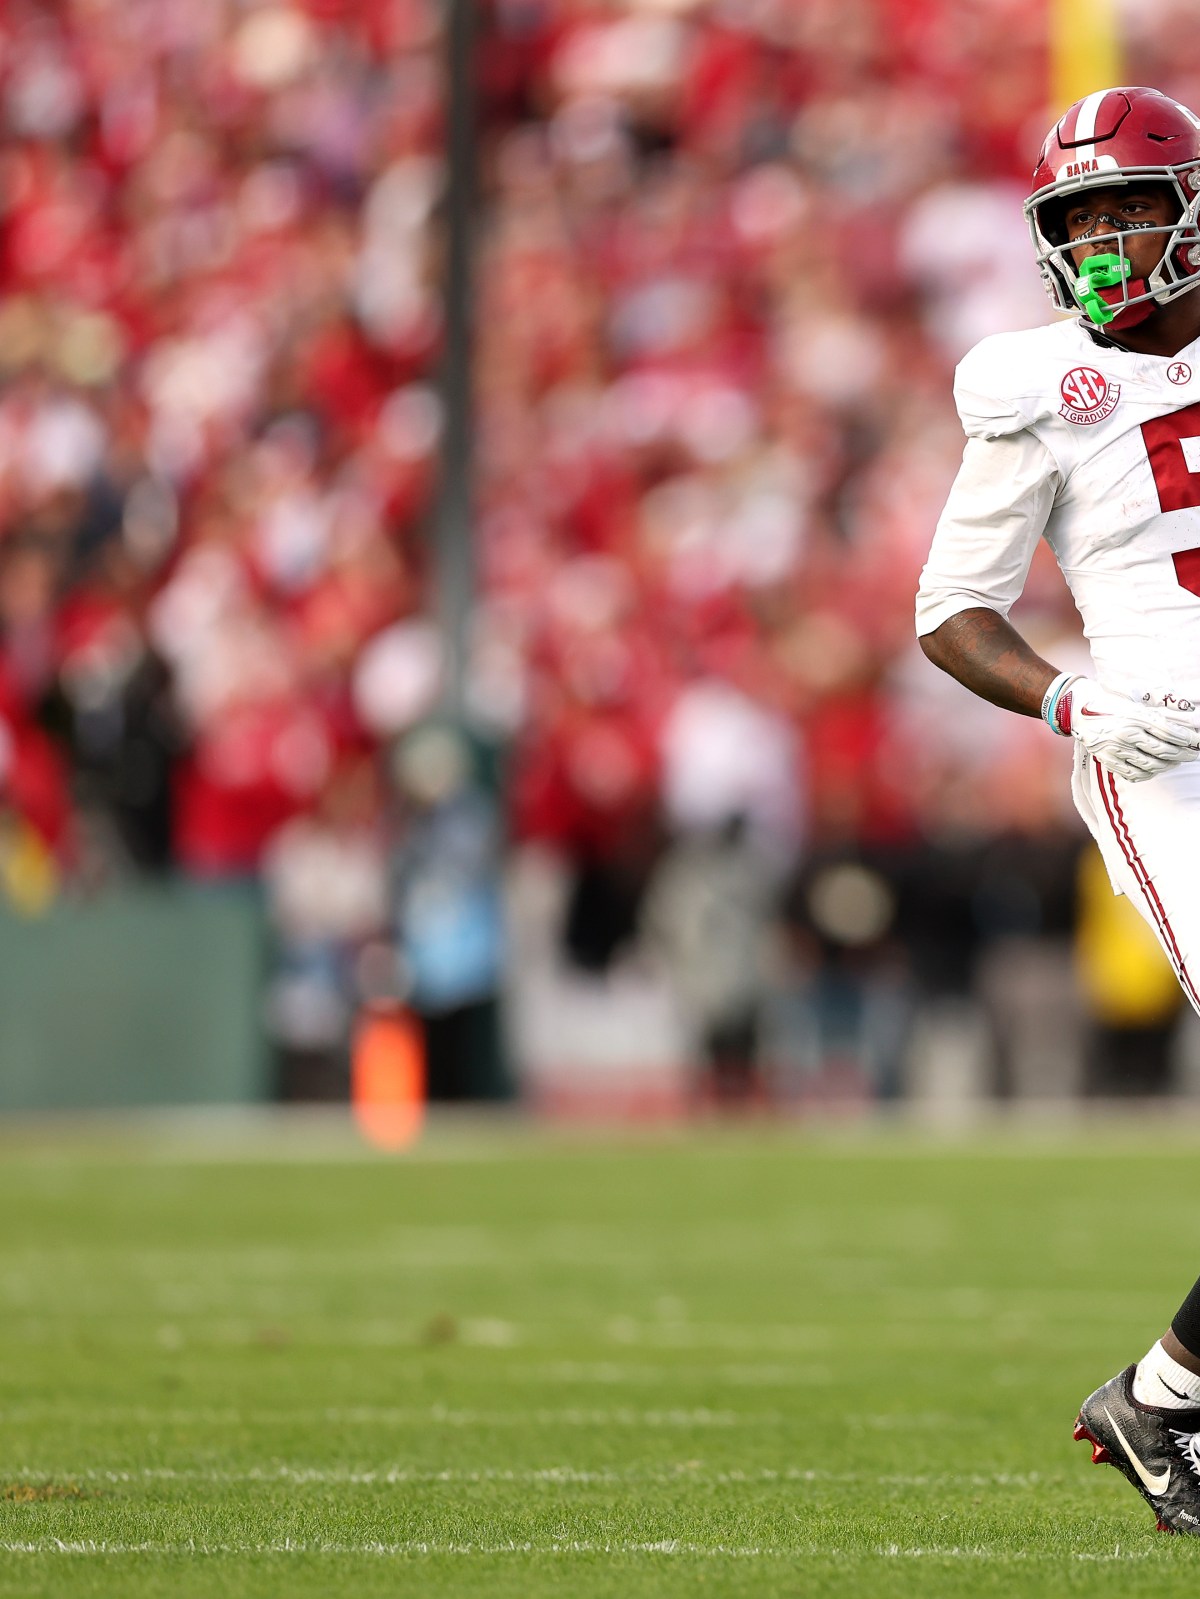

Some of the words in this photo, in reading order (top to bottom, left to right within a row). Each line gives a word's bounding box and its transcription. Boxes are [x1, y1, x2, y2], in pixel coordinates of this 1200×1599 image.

[1066, 159, 1099, 178] BAMA
[1062, 368, 1106, 409] SEC
[1069, 395, 1117, 423] GRADUATE
